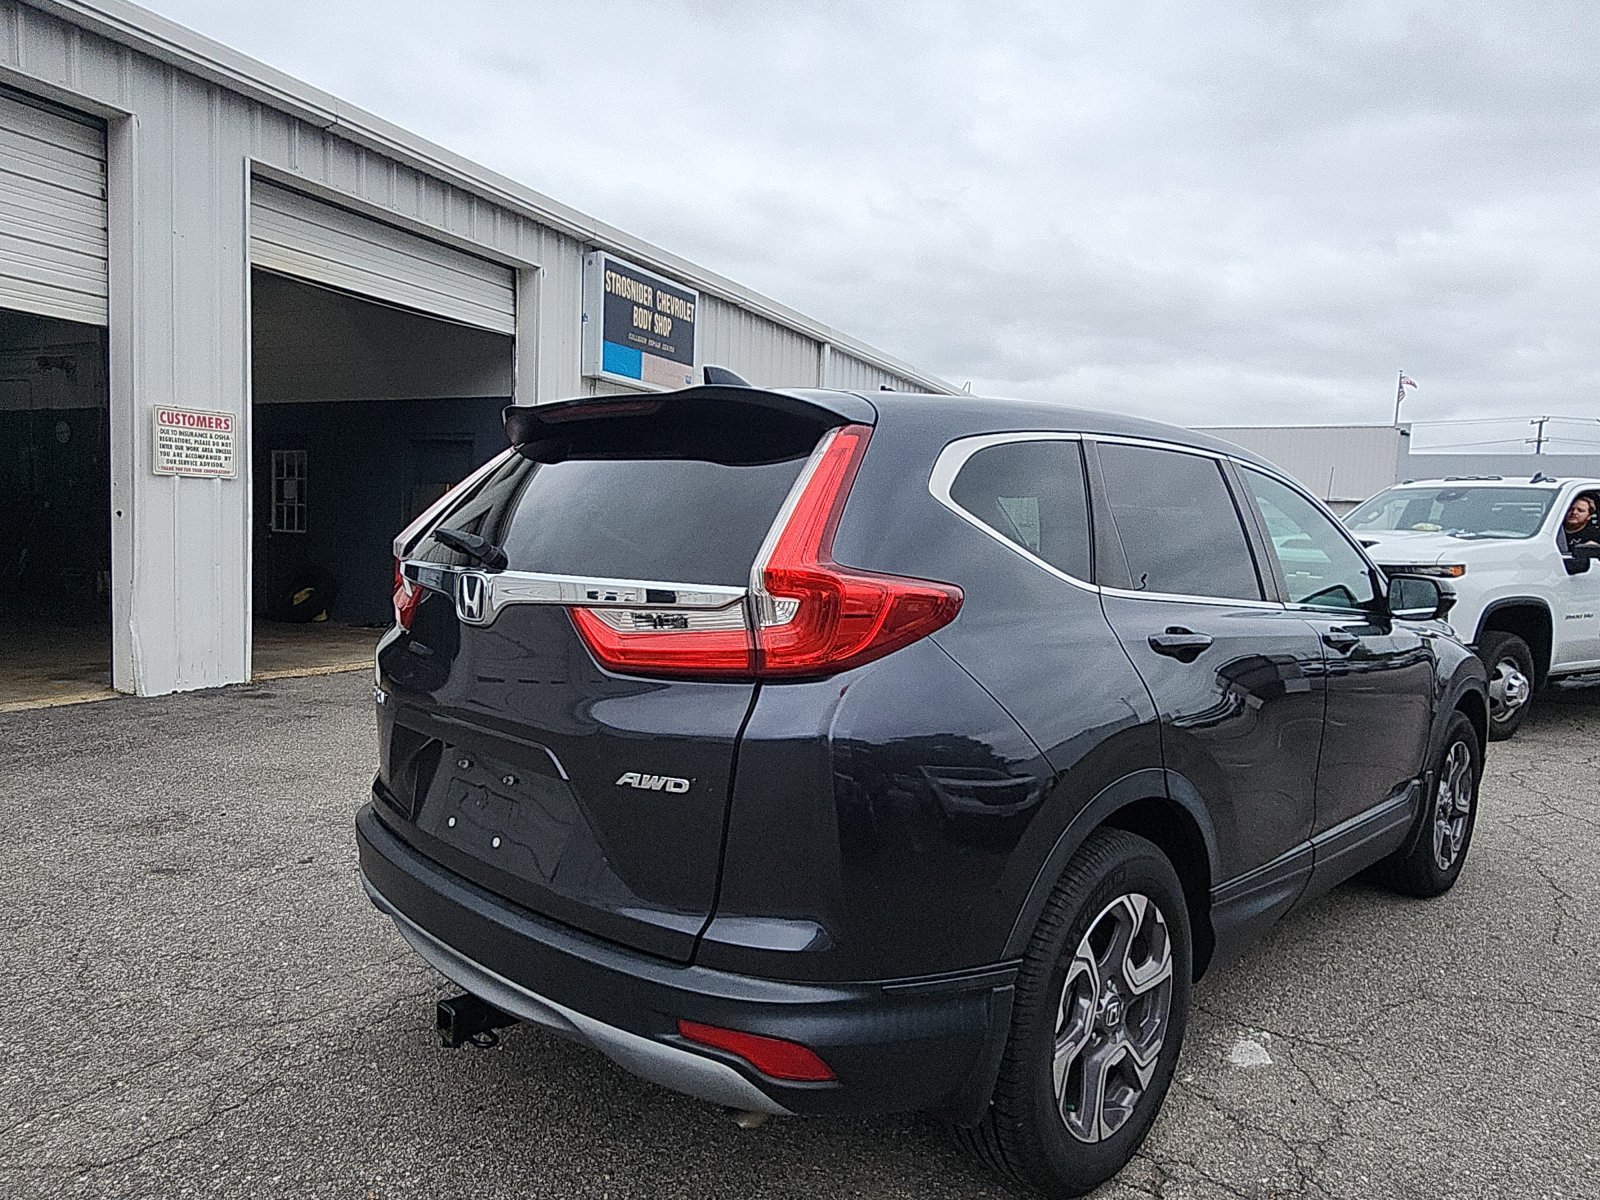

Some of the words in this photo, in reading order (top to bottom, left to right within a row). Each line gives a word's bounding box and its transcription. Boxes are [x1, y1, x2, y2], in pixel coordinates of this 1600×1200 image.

[605, 270, 653, 307] STROSNIDER
[656, 290, 694, 323] CHEVROLET
[633, 305, 653, 331] BODY
[653, 313, 672, 338] SHOP
[160, 411, 230, 430] CUSTOMERS
[159, 436, 193, 445] REGULATIONS,
[179, 430, 208, 439] INSURANCE
[185, 453, 221, 461] ACCOMPANIED
[615, 772, 690, 794] AWD
